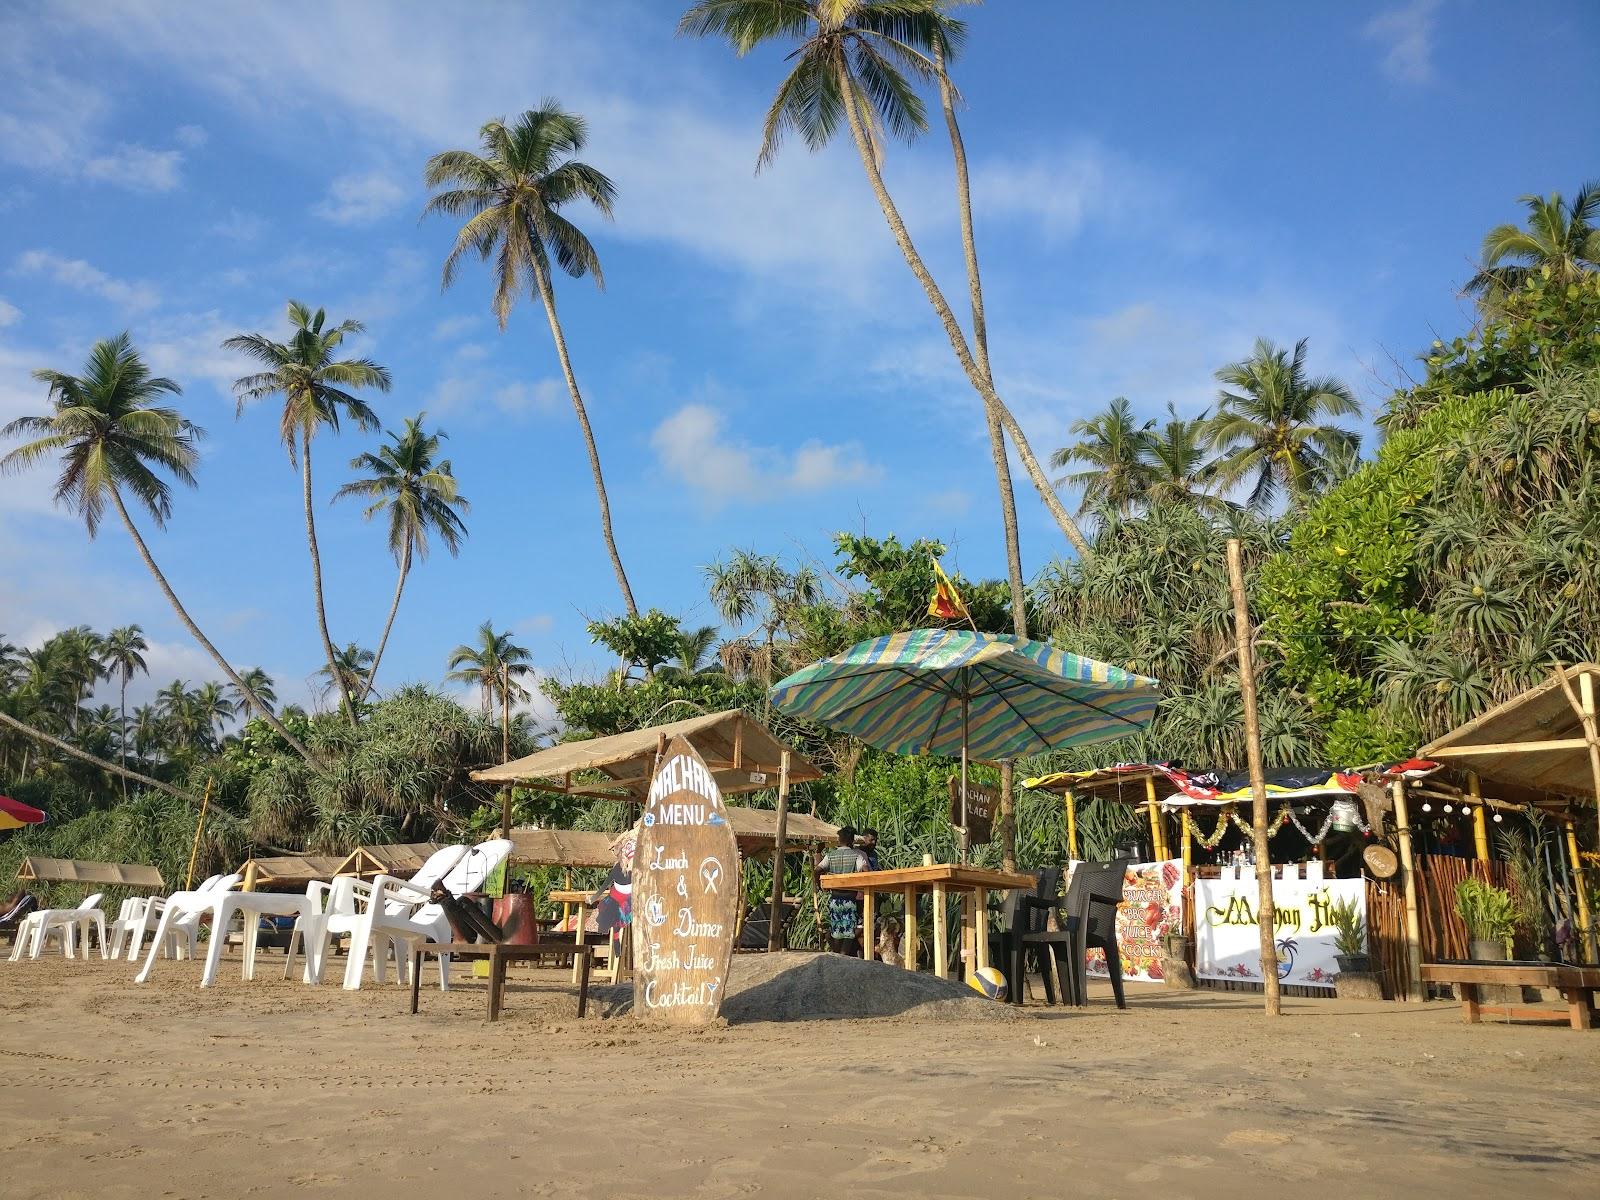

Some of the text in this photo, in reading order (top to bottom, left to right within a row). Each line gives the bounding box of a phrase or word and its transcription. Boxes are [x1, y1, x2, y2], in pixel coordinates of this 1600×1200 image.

[650, 754, 717, 809] MACHAN
[958, 785, 990, 804] MCHAN
[660, 804, 705, 826] MENU
[650, 845, 689, 870] Lunch
[677, 875, 689, 900] &
[673, 907, 723, 938] Dinner
[645, 943, 715, 972] Fresh Juice
[645, 980, 705, 1008] Cocktail
